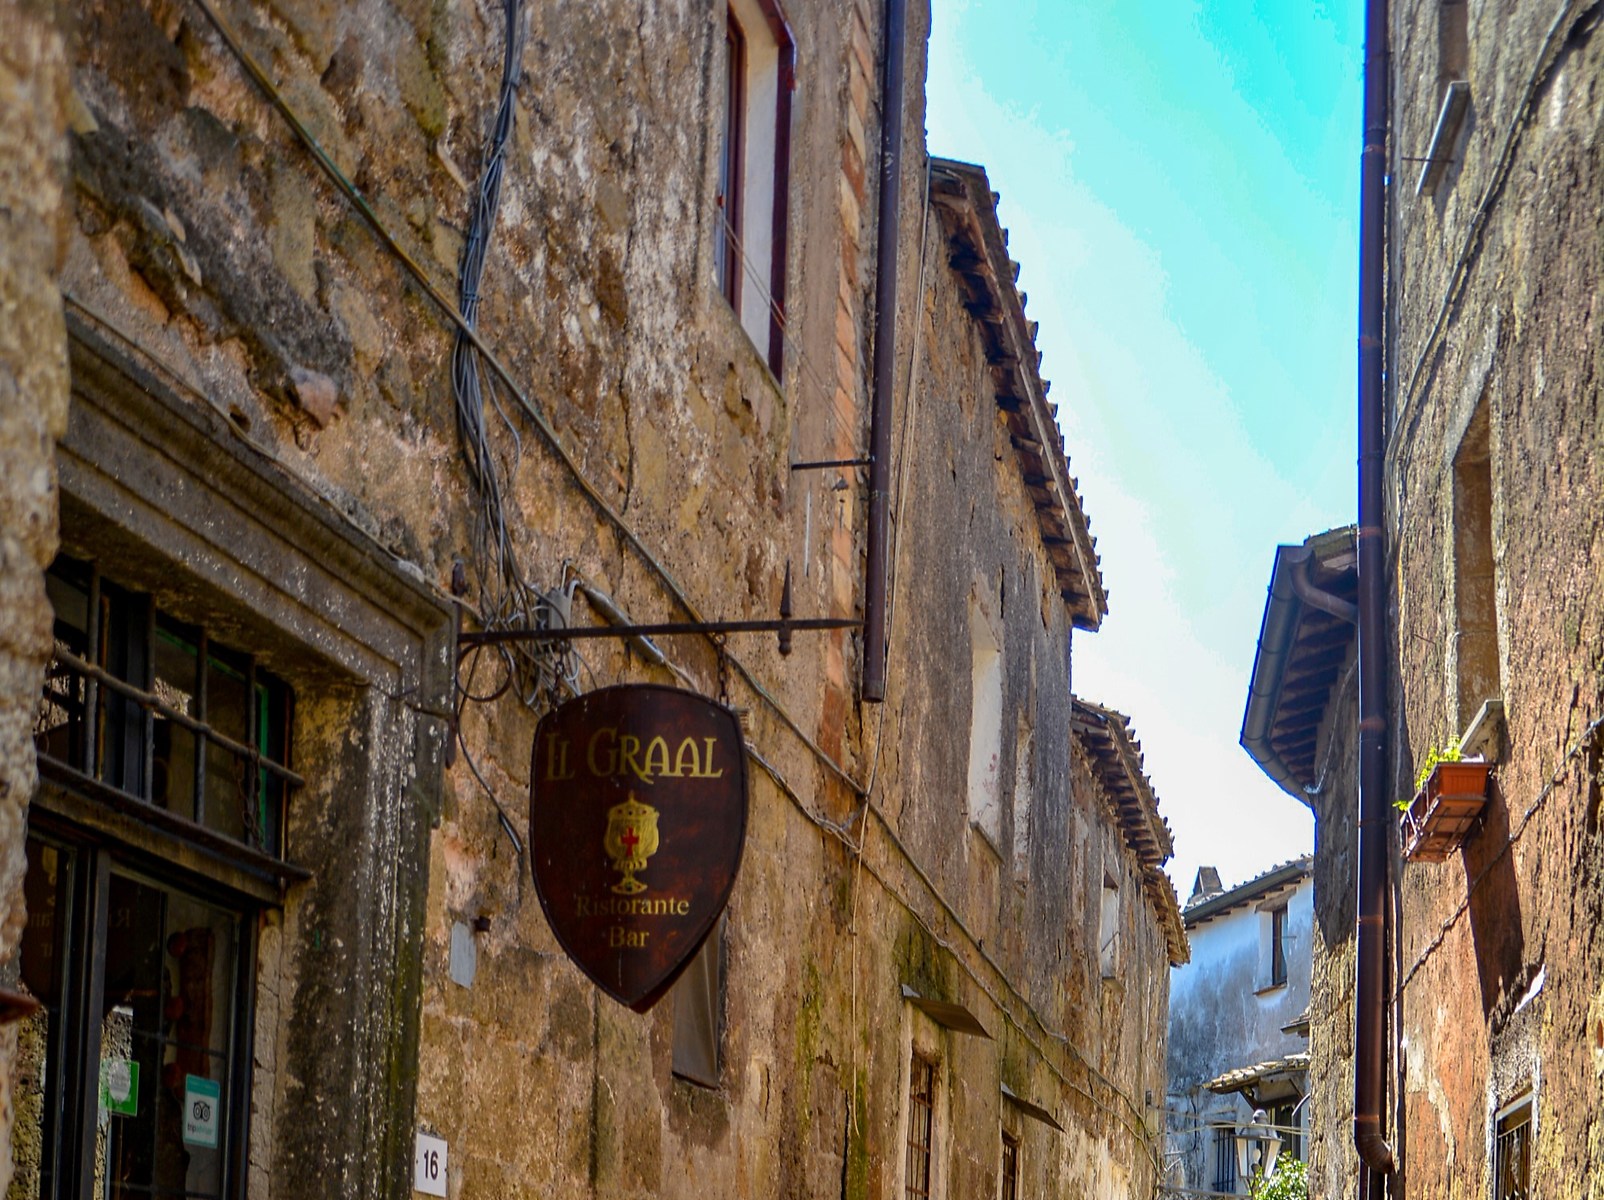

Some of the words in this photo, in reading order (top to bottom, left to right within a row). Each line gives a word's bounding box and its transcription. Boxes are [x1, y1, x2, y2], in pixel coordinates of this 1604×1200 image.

[587, 727, 724, 784] GRAAL
[576, 896, 690, 916] Ristorante
[608, 927, 650, 948] Bar
[423, 1149, 439, 1181] 16
